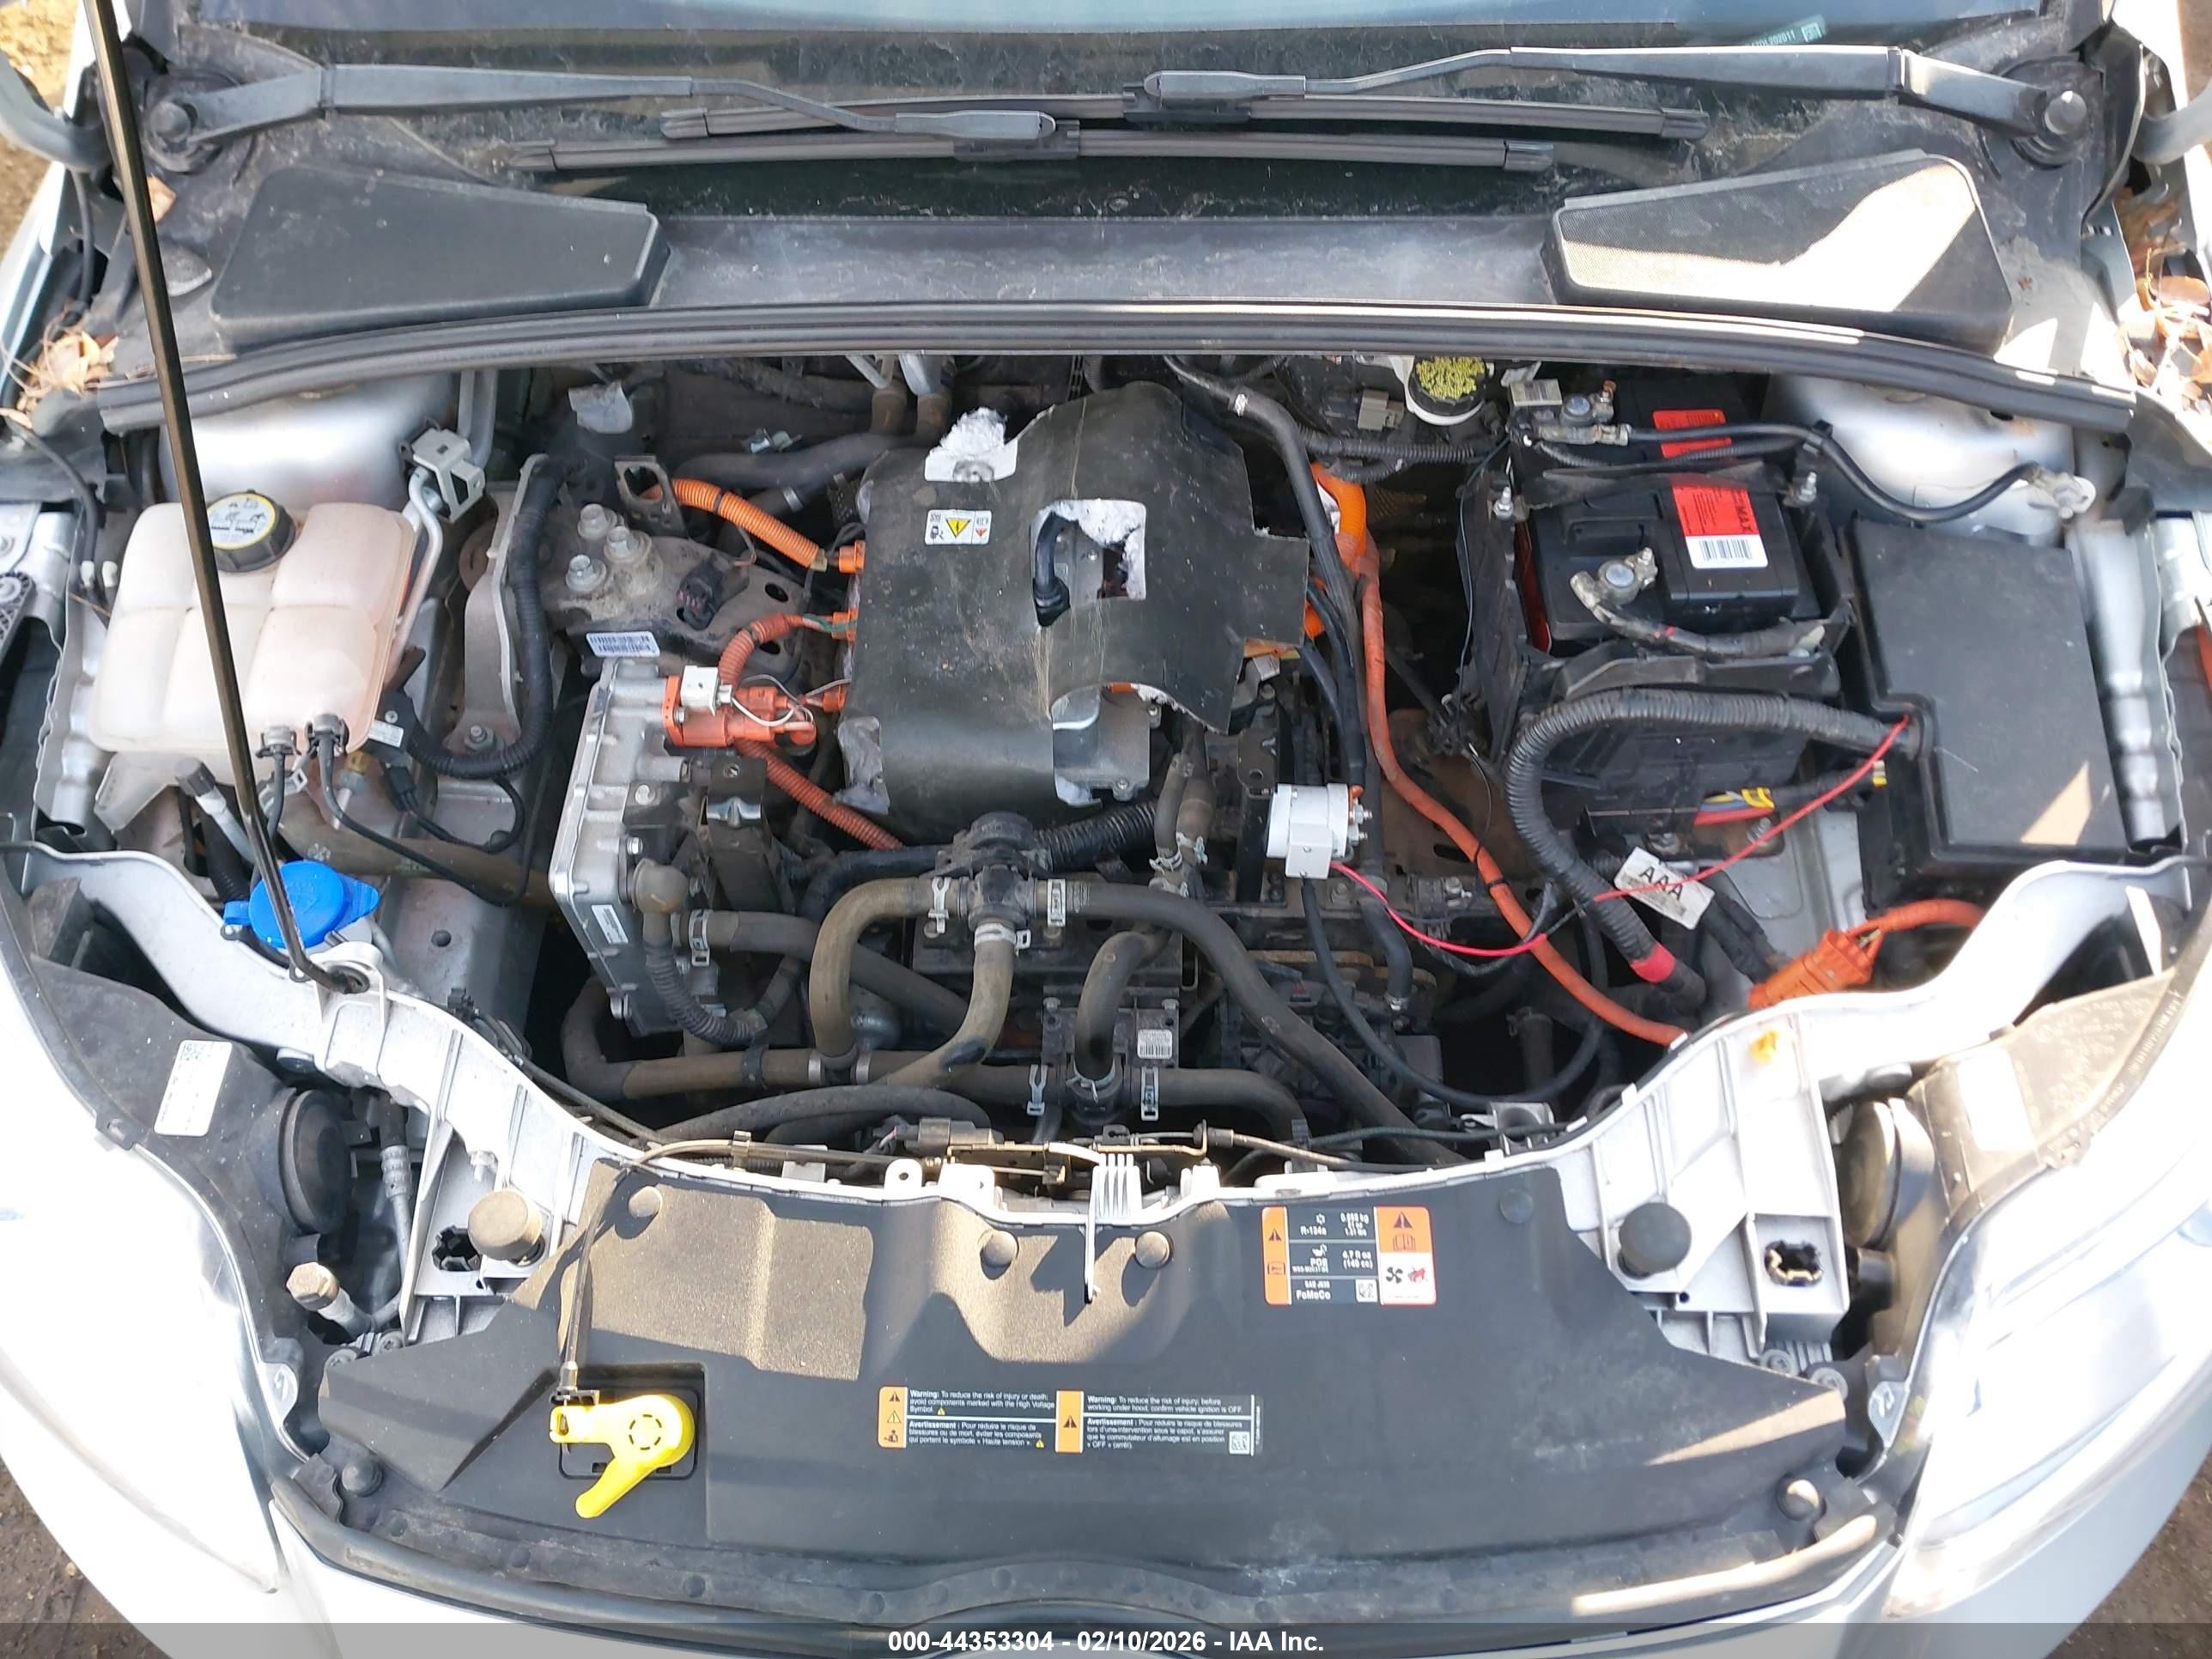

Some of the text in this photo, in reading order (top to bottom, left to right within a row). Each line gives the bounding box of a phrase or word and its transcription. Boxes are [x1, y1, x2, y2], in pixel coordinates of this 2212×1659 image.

[1638, 866, 1684, 901] AAA
[1296, 1290, 1331, 1300] FoMoCo
[909, 1389, 939, 1399] Warning:
[1004, 1392, 1019, 1401] injury
[1087, 1395, 1116, 1405] Warning:
[928, 1400, 965, 1408] components
[1175, 1405, 1196, 1413] vehicle
[1198, 1406, 1220, 1414] ignition
[909, 1420, 957, 1429] Avertissement
[1087, 1418, 1133, 1426] Avertissement
[1184, 1420, 1202, 1429] risque
[1005, 1431, 1042, 1440] composants
